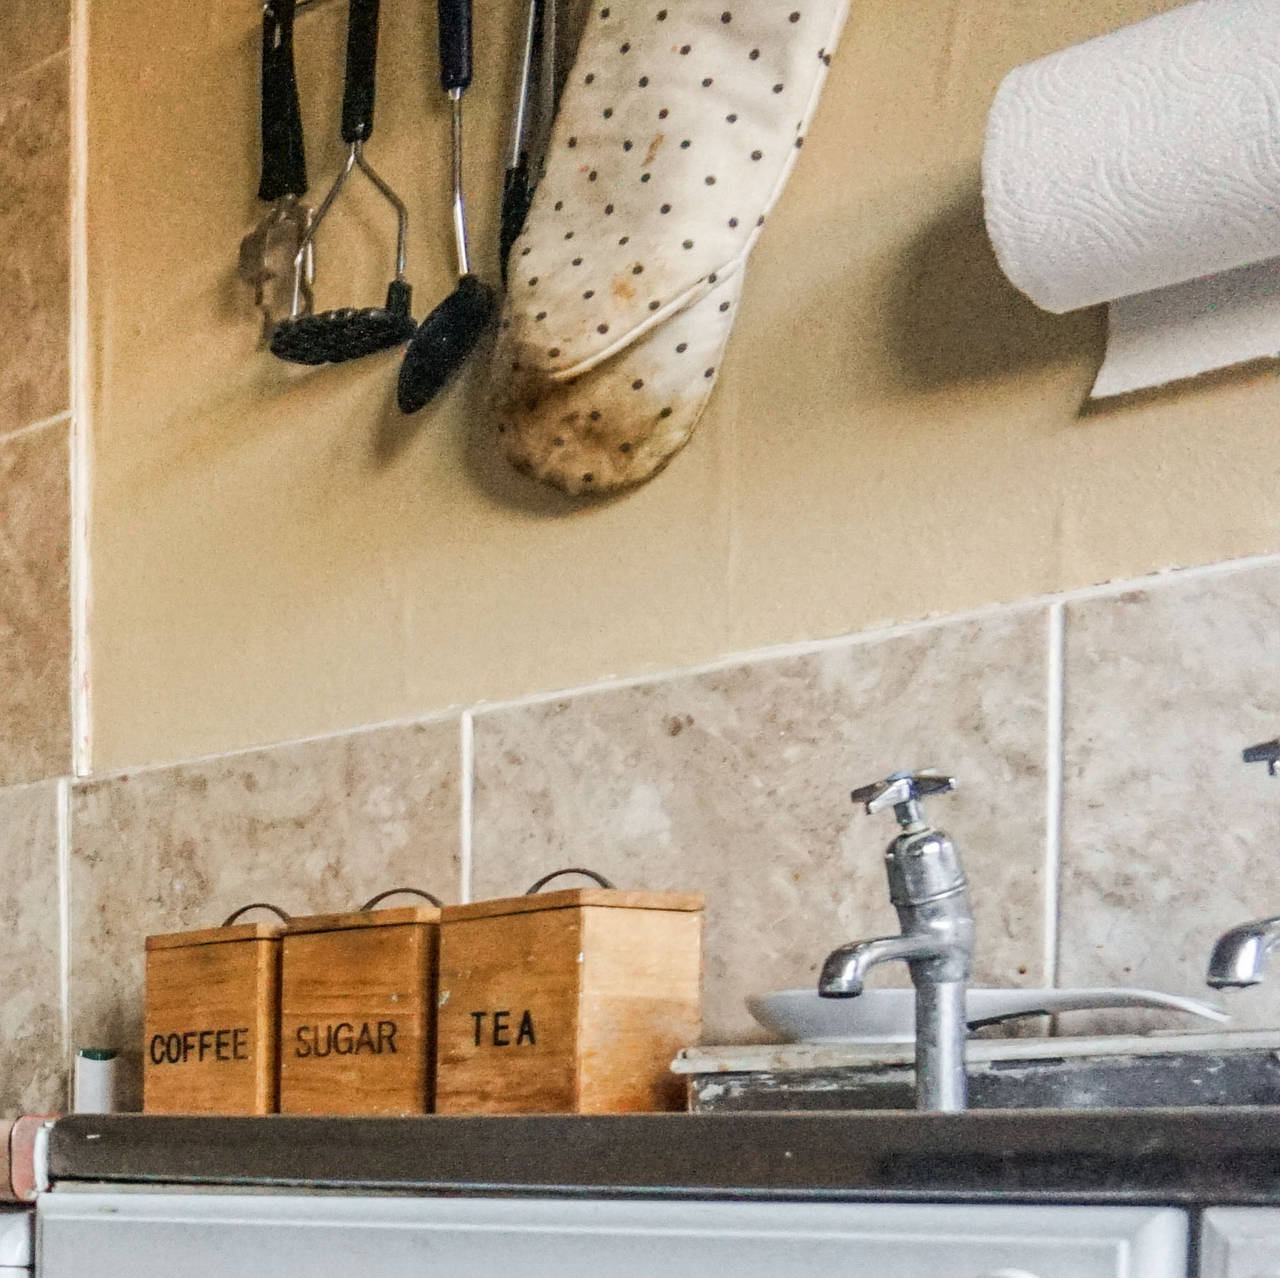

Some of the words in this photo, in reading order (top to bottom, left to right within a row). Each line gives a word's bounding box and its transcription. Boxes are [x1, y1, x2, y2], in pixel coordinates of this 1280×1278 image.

[149, 1027, 250, 1065] COFFEE
[295, 1019, 399, 1059] SUGAR
[470, 1009, 537, 1047] TEA
